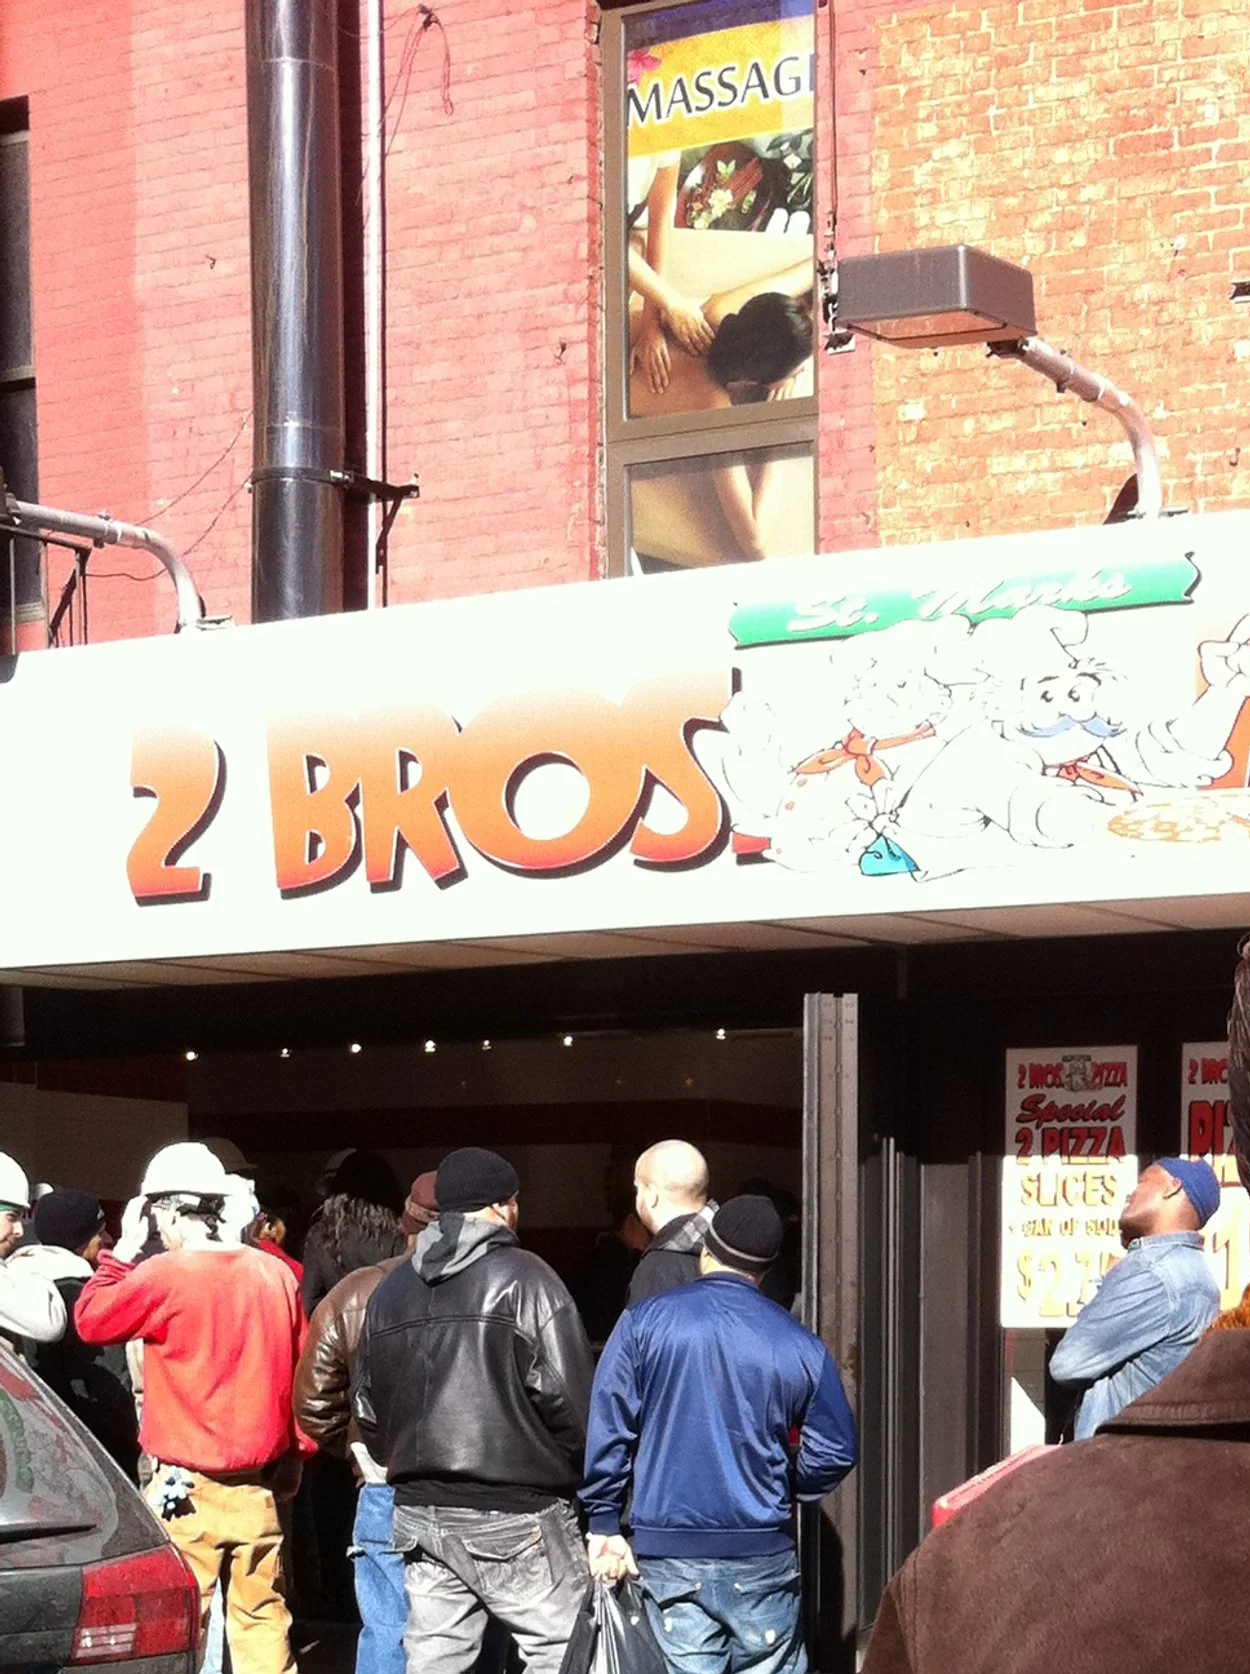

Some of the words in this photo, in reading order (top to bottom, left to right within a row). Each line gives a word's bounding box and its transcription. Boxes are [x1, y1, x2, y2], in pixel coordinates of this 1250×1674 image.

[126, 725, 229, 908] 2
[1016, 1093, 1127, 1129] Special
[1015, 1127, 1033, 1165] 2
[1041, 1127, 1126, 1165] PIZZA
[1021, 1171, 1118, 1207] SLICES
